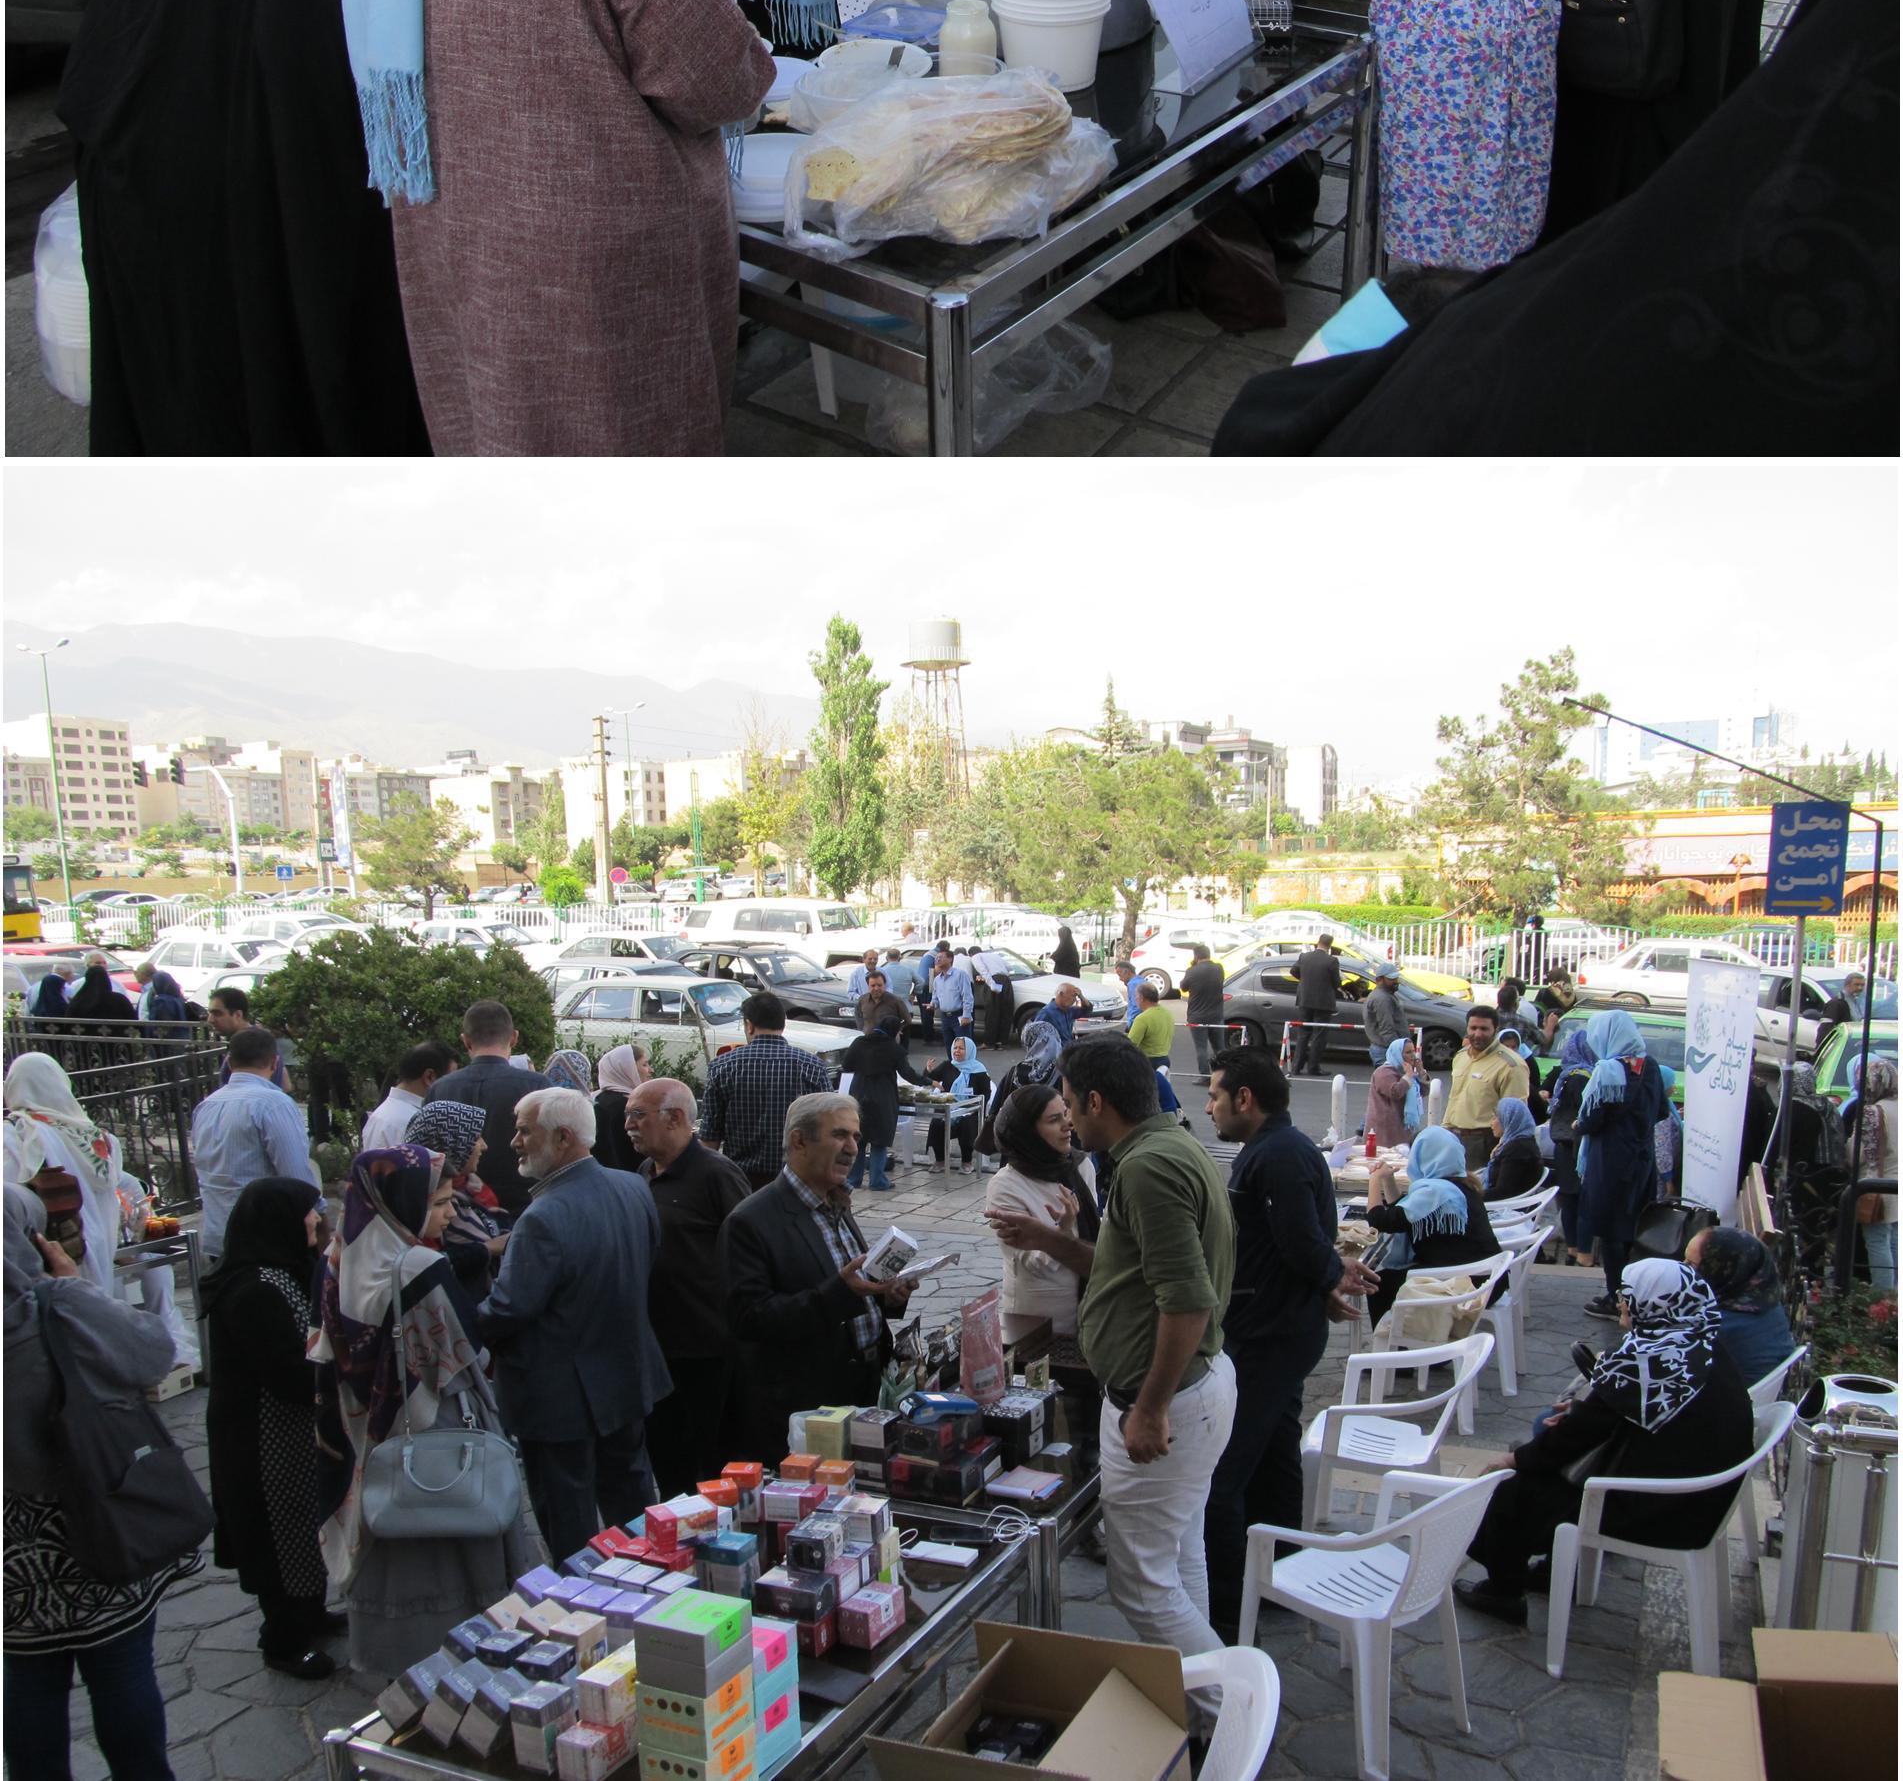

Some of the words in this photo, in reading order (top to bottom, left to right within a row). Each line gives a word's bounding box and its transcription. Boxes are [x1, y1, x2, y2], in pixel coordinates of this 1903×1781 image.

[1779, 810, 1842, 837] محل
[1777, 838, 1840, 865] تجمع
[1775, 866, 1838, 892] امن
